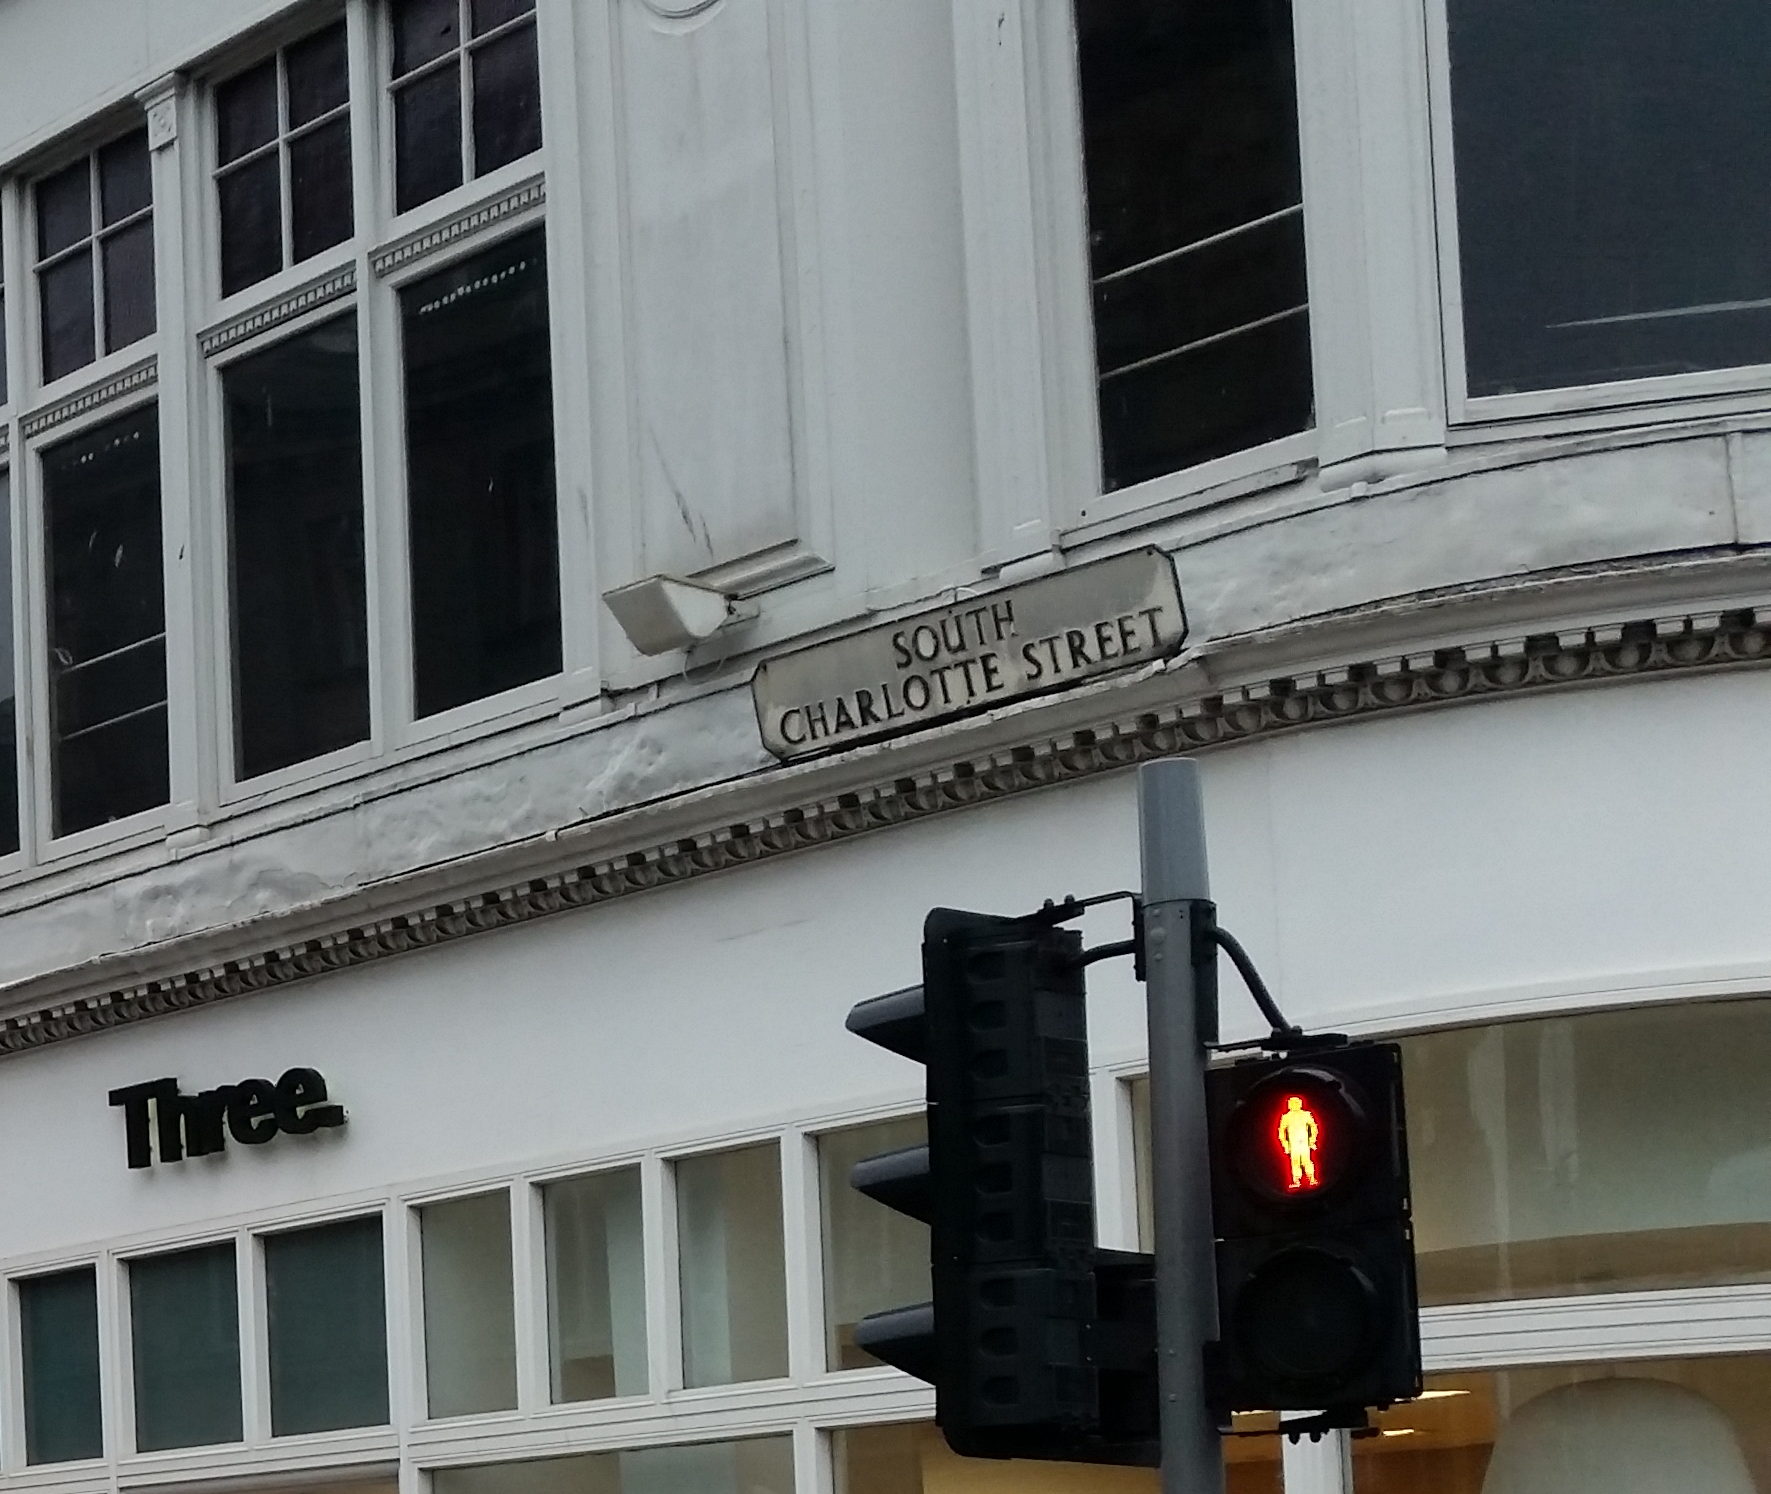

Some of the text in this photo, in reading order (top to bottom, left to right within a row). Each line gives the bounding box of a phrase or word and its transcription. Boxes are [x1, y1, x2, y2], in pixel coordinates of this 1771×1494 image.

[778, 606, 1165, 746] CHARLOTTE STREET
[891, 599, 1018, 671] SOUTH
